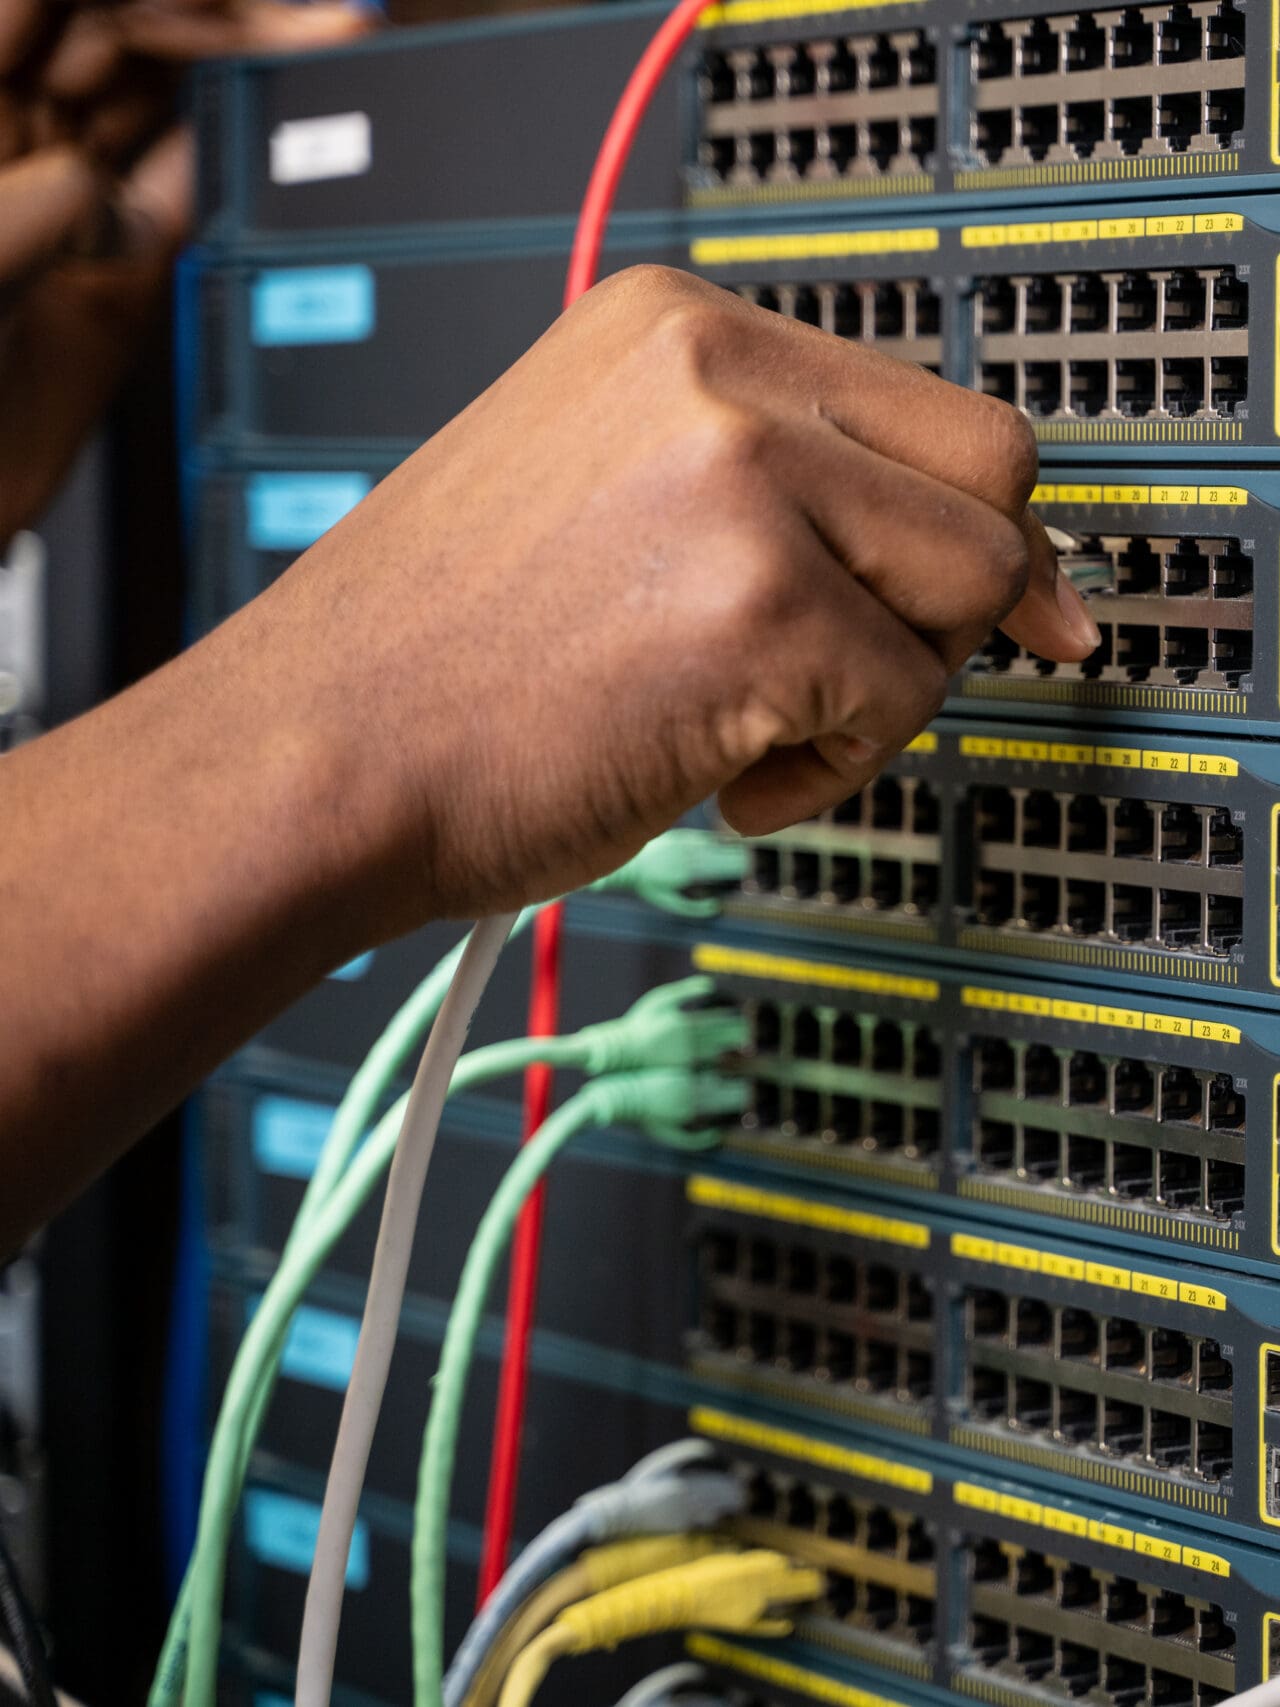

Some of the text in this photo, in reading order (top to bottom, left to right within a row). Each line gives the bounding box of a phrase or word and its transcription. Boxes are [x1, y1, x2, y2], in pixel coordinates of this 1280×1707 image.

[1155, 221, 1164, 232] 21
[1175, 220, 1184, 231] 22
[1204, 218, 1213, 230] 23
[1224, 217, 1233, 229] 24
[1160, 490, 1169, 502] 21
[1180, 490, 1189, 502] 22
[1209, 490, 1218, 502] 23
[1228, 491, 1238, 503] 24
[1151, 756, 1159, 767] 21
[1170, 758, 1178, 769] 22
[1199, 760, 1208, 771] 23
[1218, 761, 1227, 774] 24
[1153, 1018, 1162, 1029] 21
[1173, 1021, 1182, 1032] 22
[1202, 1025, 1211, 1037] 23
[1221, 1028, 1231, 1040] 24
[1140, 1279, 1149, 1291] 21
[1160, 1283, 1168, 1295] 22
[1188, 1289, 1197, 1302] 23
[1207, 1294, 1216, 1306] 24
[1143, 1540, 1152, 1551] 21
[1162, 1545, 1172, 1558] 22
[1191, 1553, 1201, 1567] 23
[1211, 1558, 1220, 1573] 24
